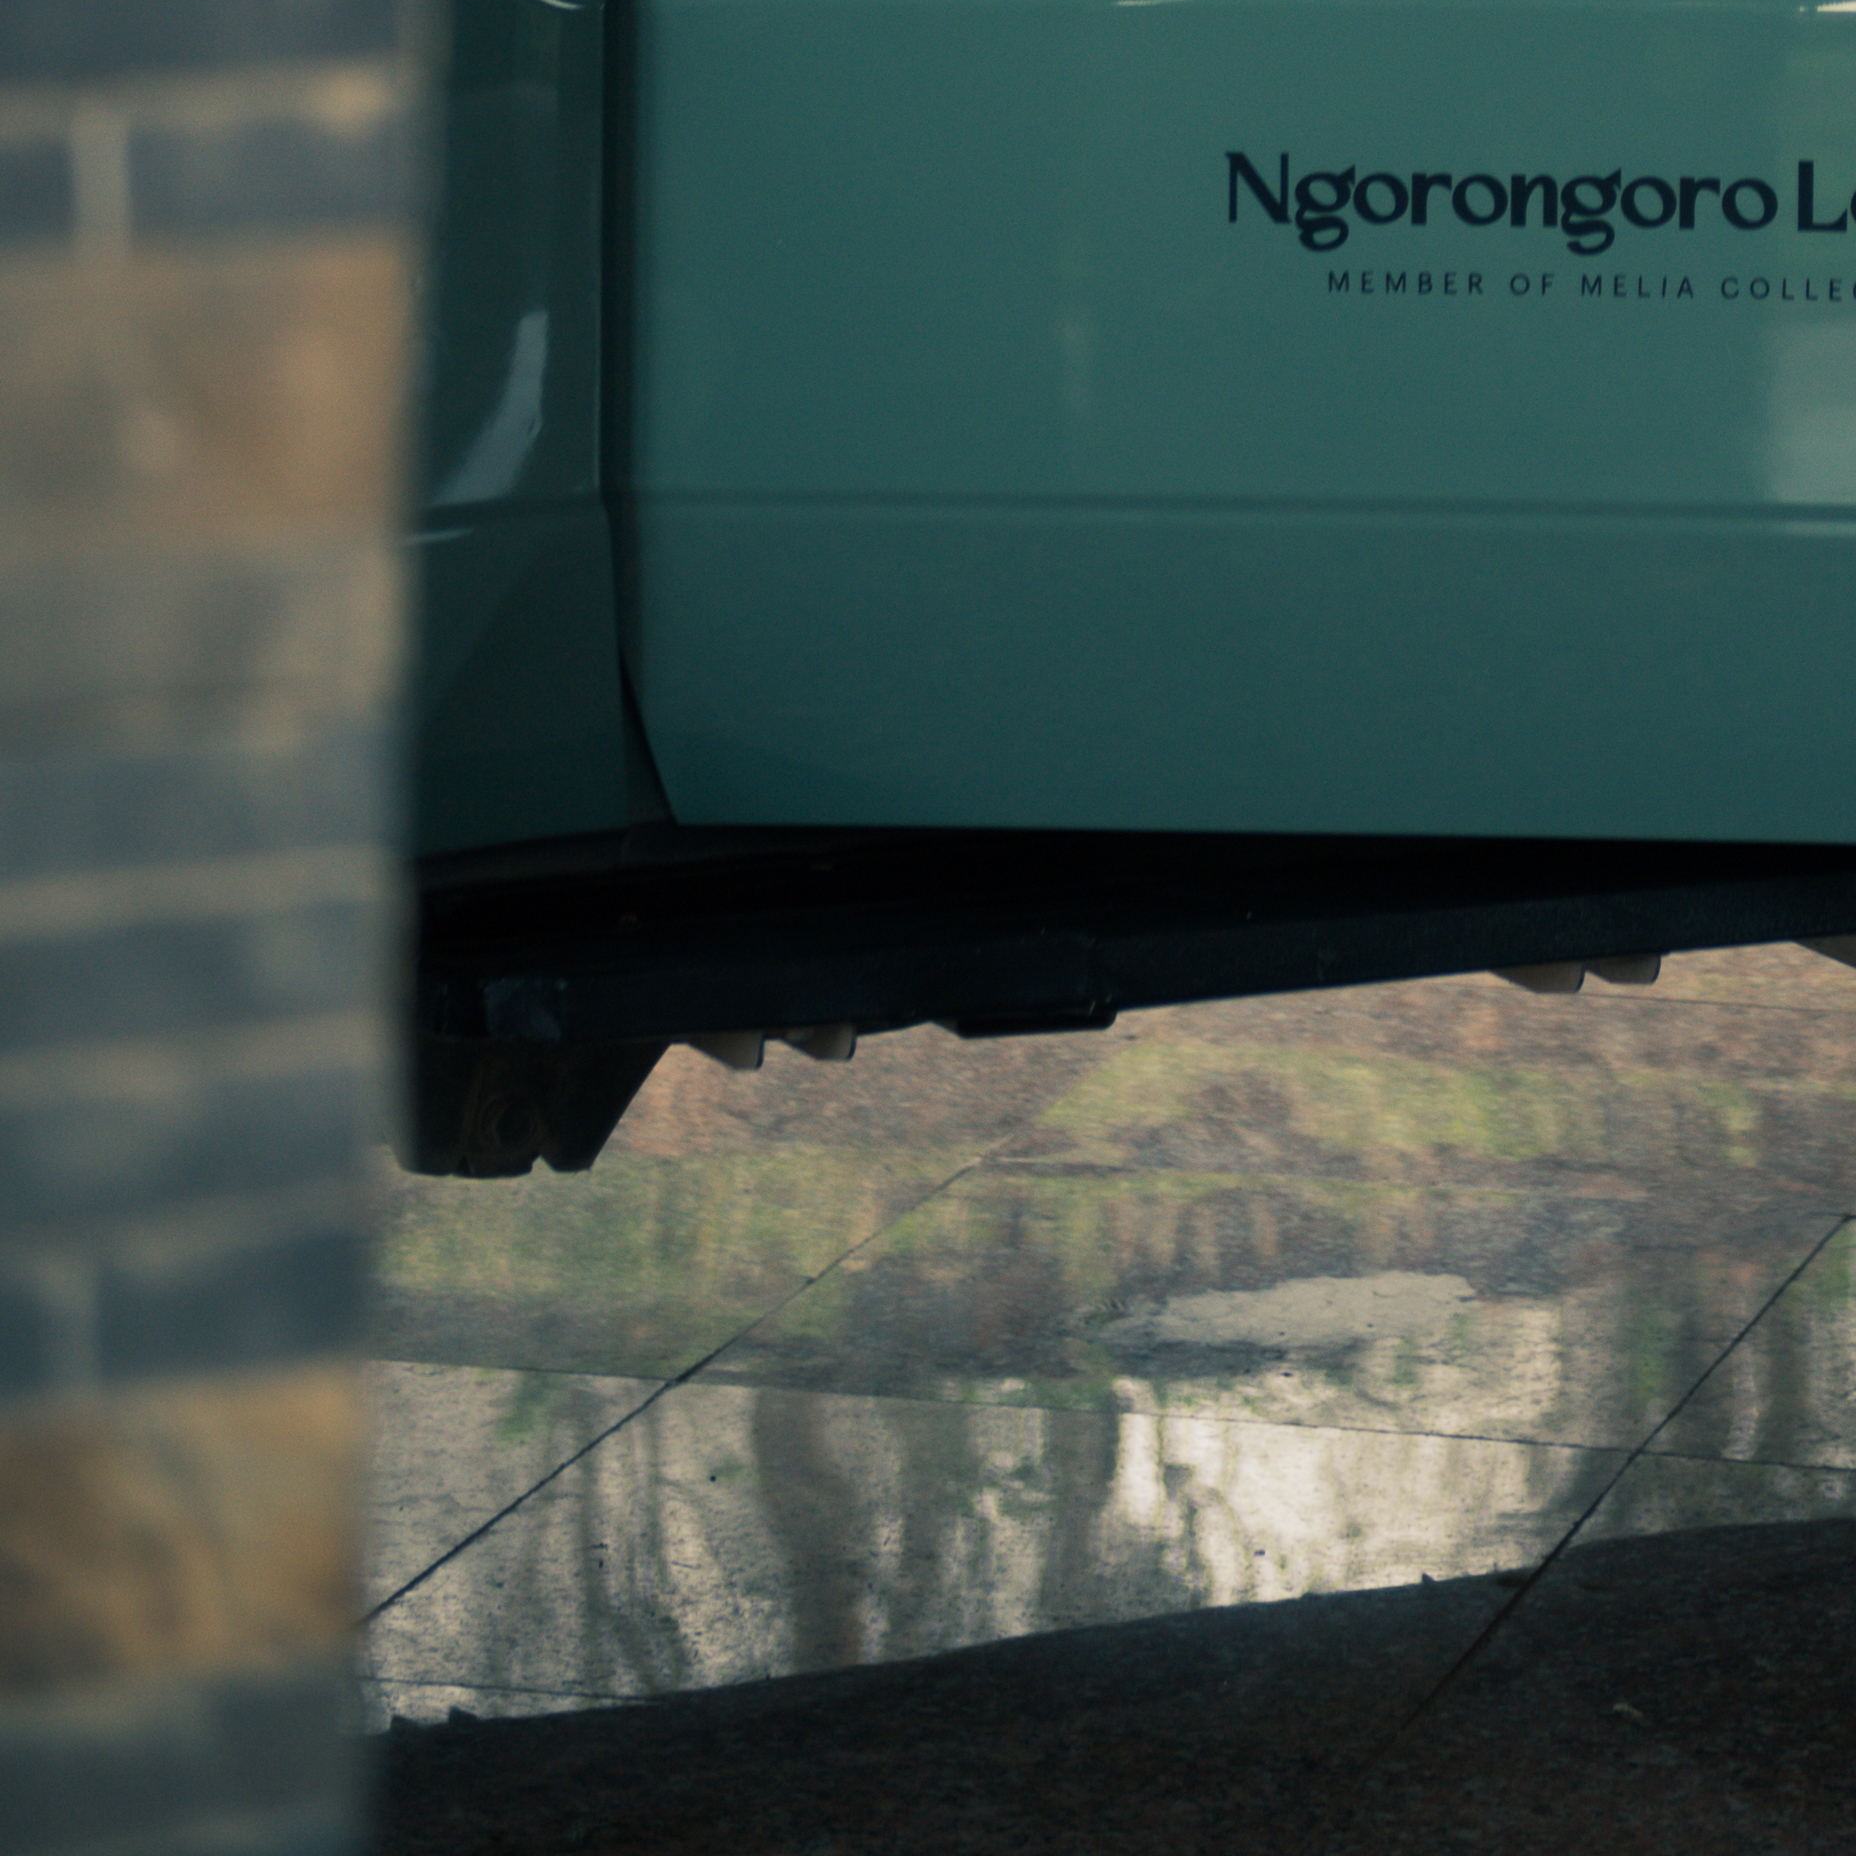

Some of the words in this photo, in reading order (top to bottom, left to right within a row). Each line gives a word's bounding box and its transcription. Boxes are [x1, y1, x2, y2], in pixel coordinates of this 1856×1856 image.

[1224, 150, 1779, 257] Ngorongoro
[1327, 270, 1483, 295] MEMBER
[1508, 272, 1554, 297] OF
[1580, 273, 1694, 299] MELIA
